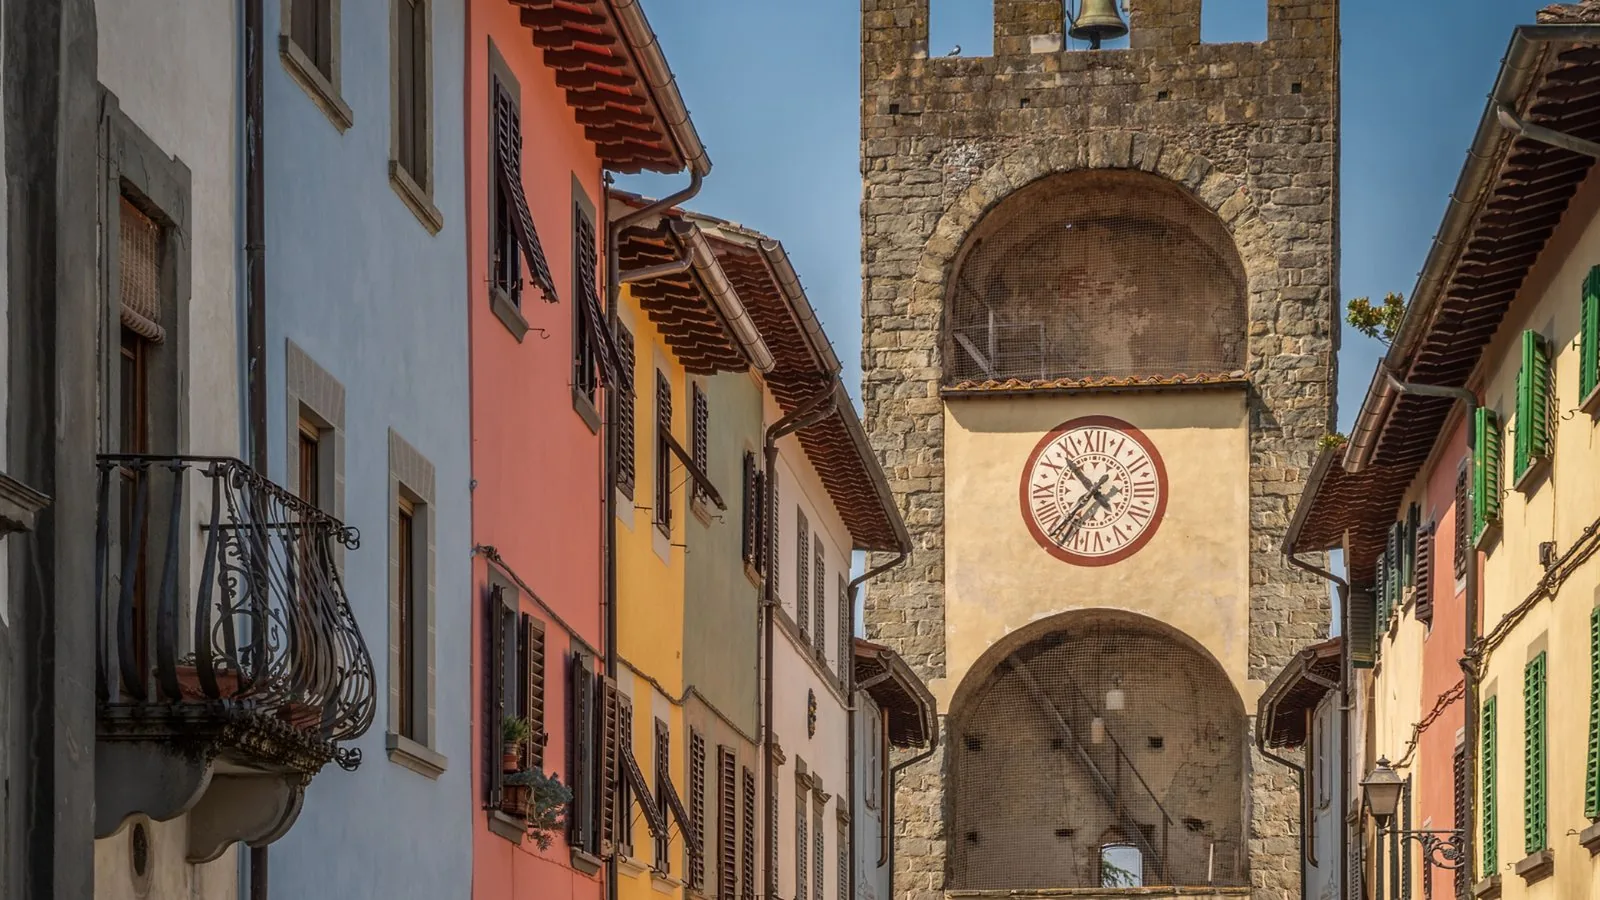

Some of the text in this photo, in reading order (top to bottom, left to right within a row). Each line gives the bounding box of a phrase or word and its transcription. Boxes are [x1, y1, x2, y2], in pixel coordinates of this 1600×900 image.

[1058, 436, 1080, 460] XI
[1084, 430, 1107, 453] XII
[1113, 437, 1126, 457] I
[1040, 454, 1063, 476] X
[1126, 454, 1149, 474] II
[1032, 483, 1055, 499] IX
[1133, 480, 1155, 498] III
[1035, 501, 1061, 533] VIII
[1127, 504, 1151, 527] IV
[1083, 531, 1104, 552] VI
[1112, 525, 1130, 546] V
